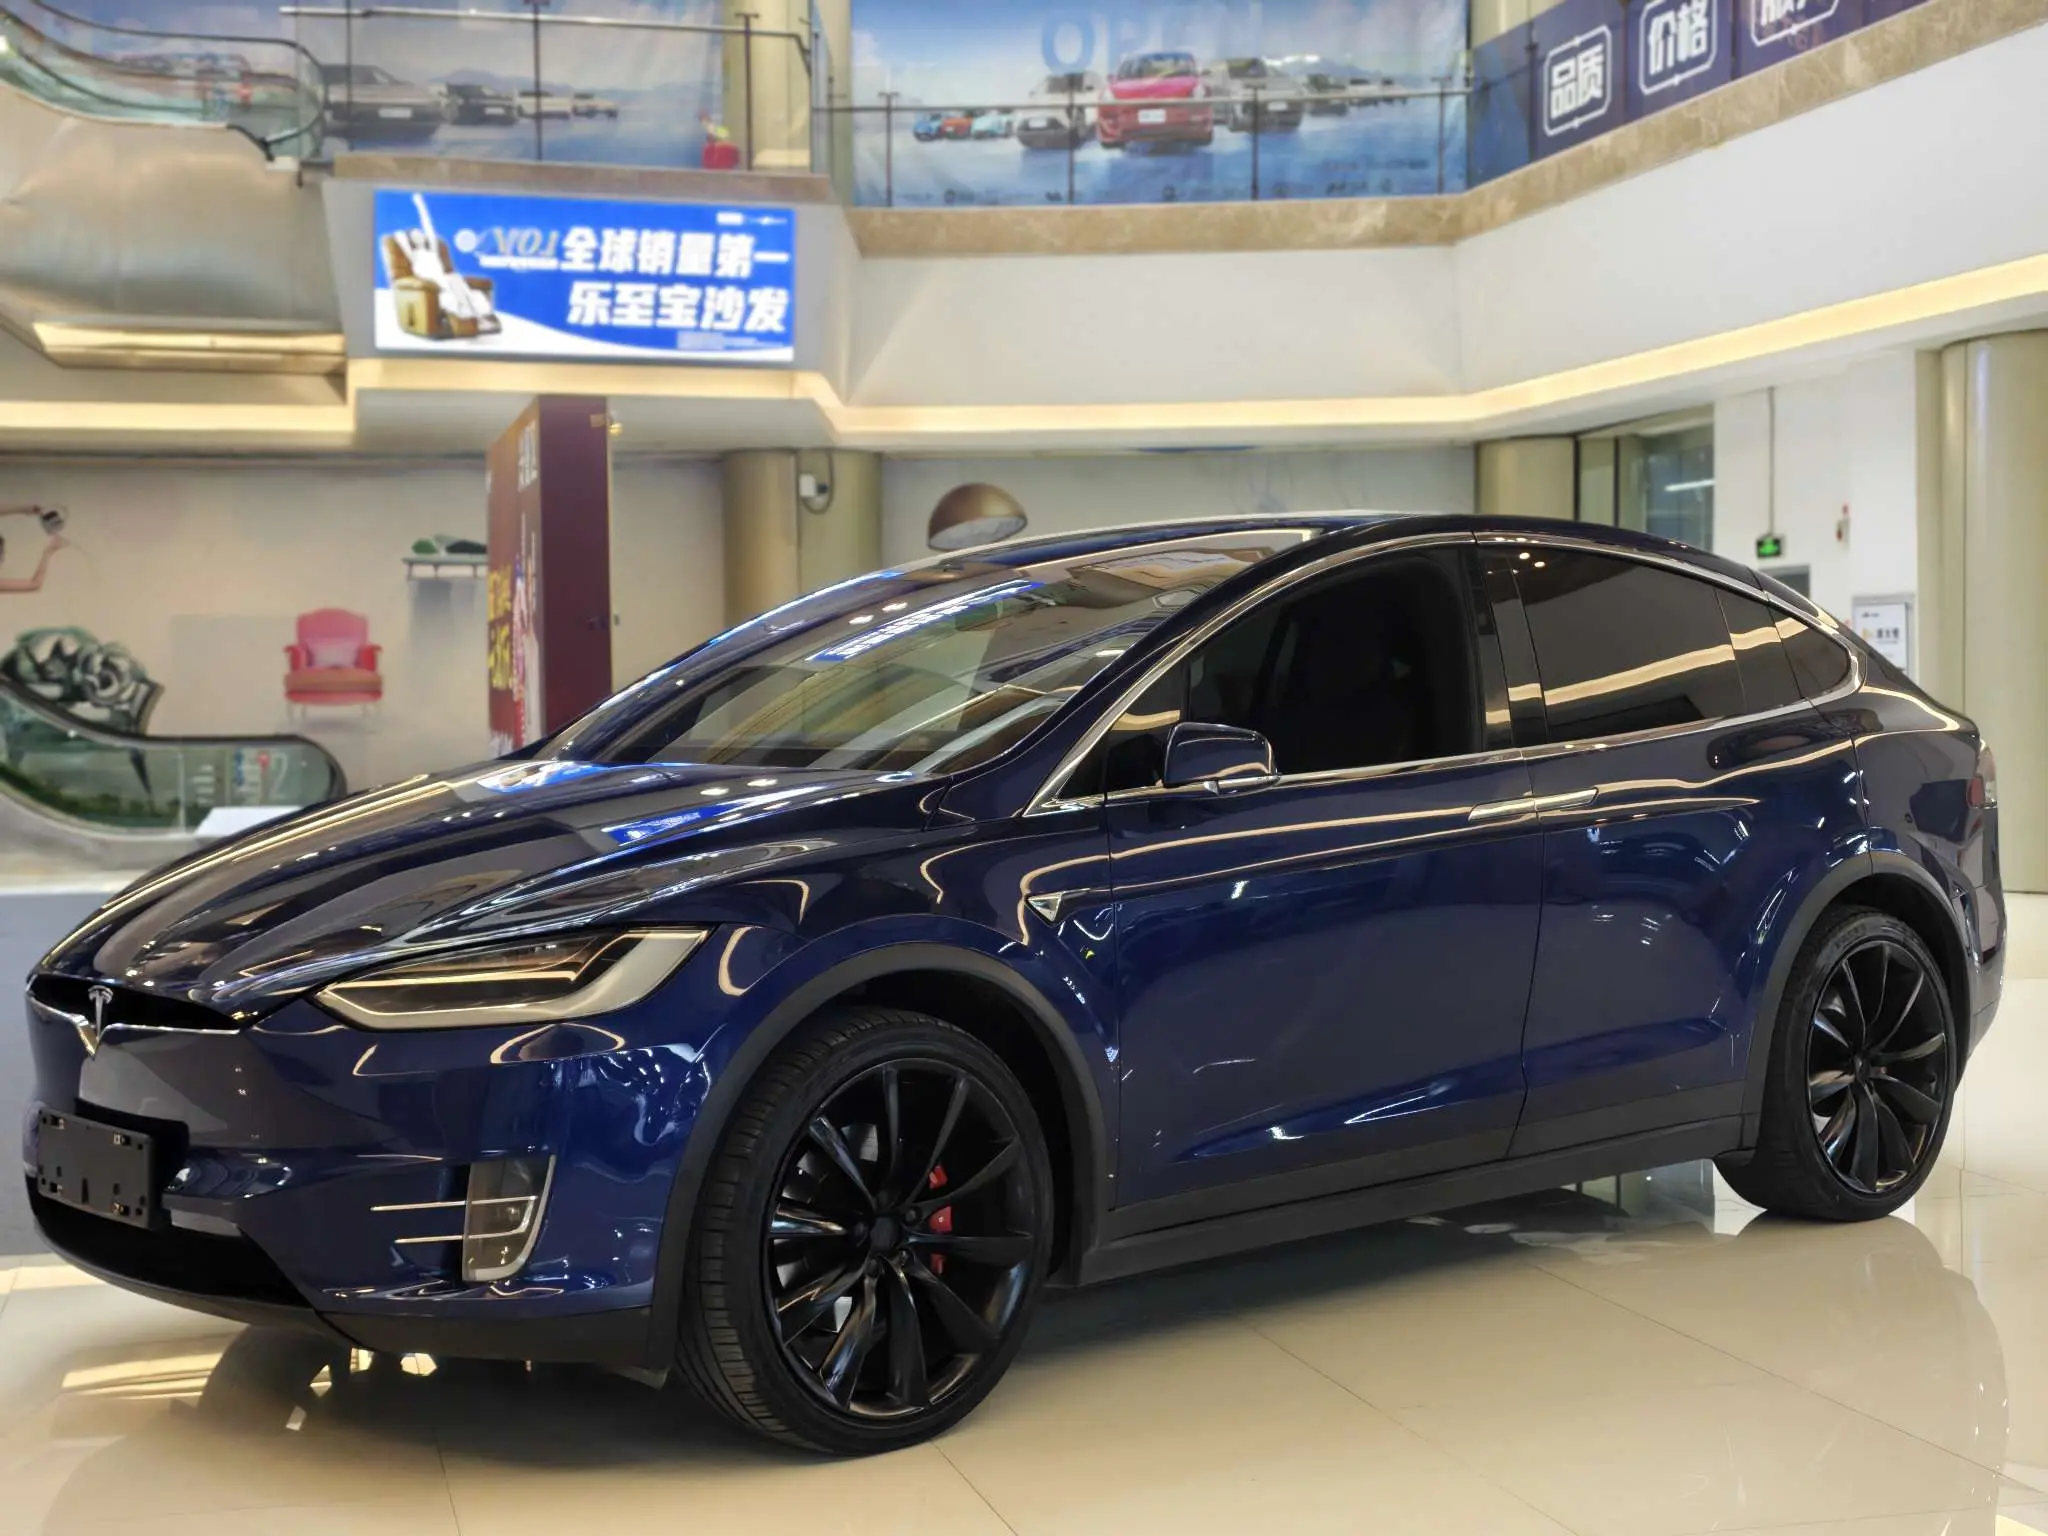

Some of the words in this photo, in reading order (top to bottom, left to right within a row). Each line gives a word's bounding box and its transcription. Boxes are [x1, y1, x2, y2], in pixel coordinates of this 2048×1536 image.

[1648, 0, 1709, 76] 价格
[1550, 43, 1604, 119] 品质
[559, 226, 790, 279] 全球销量第一
[566, 280, 789, 333] 乐至宝沙发
